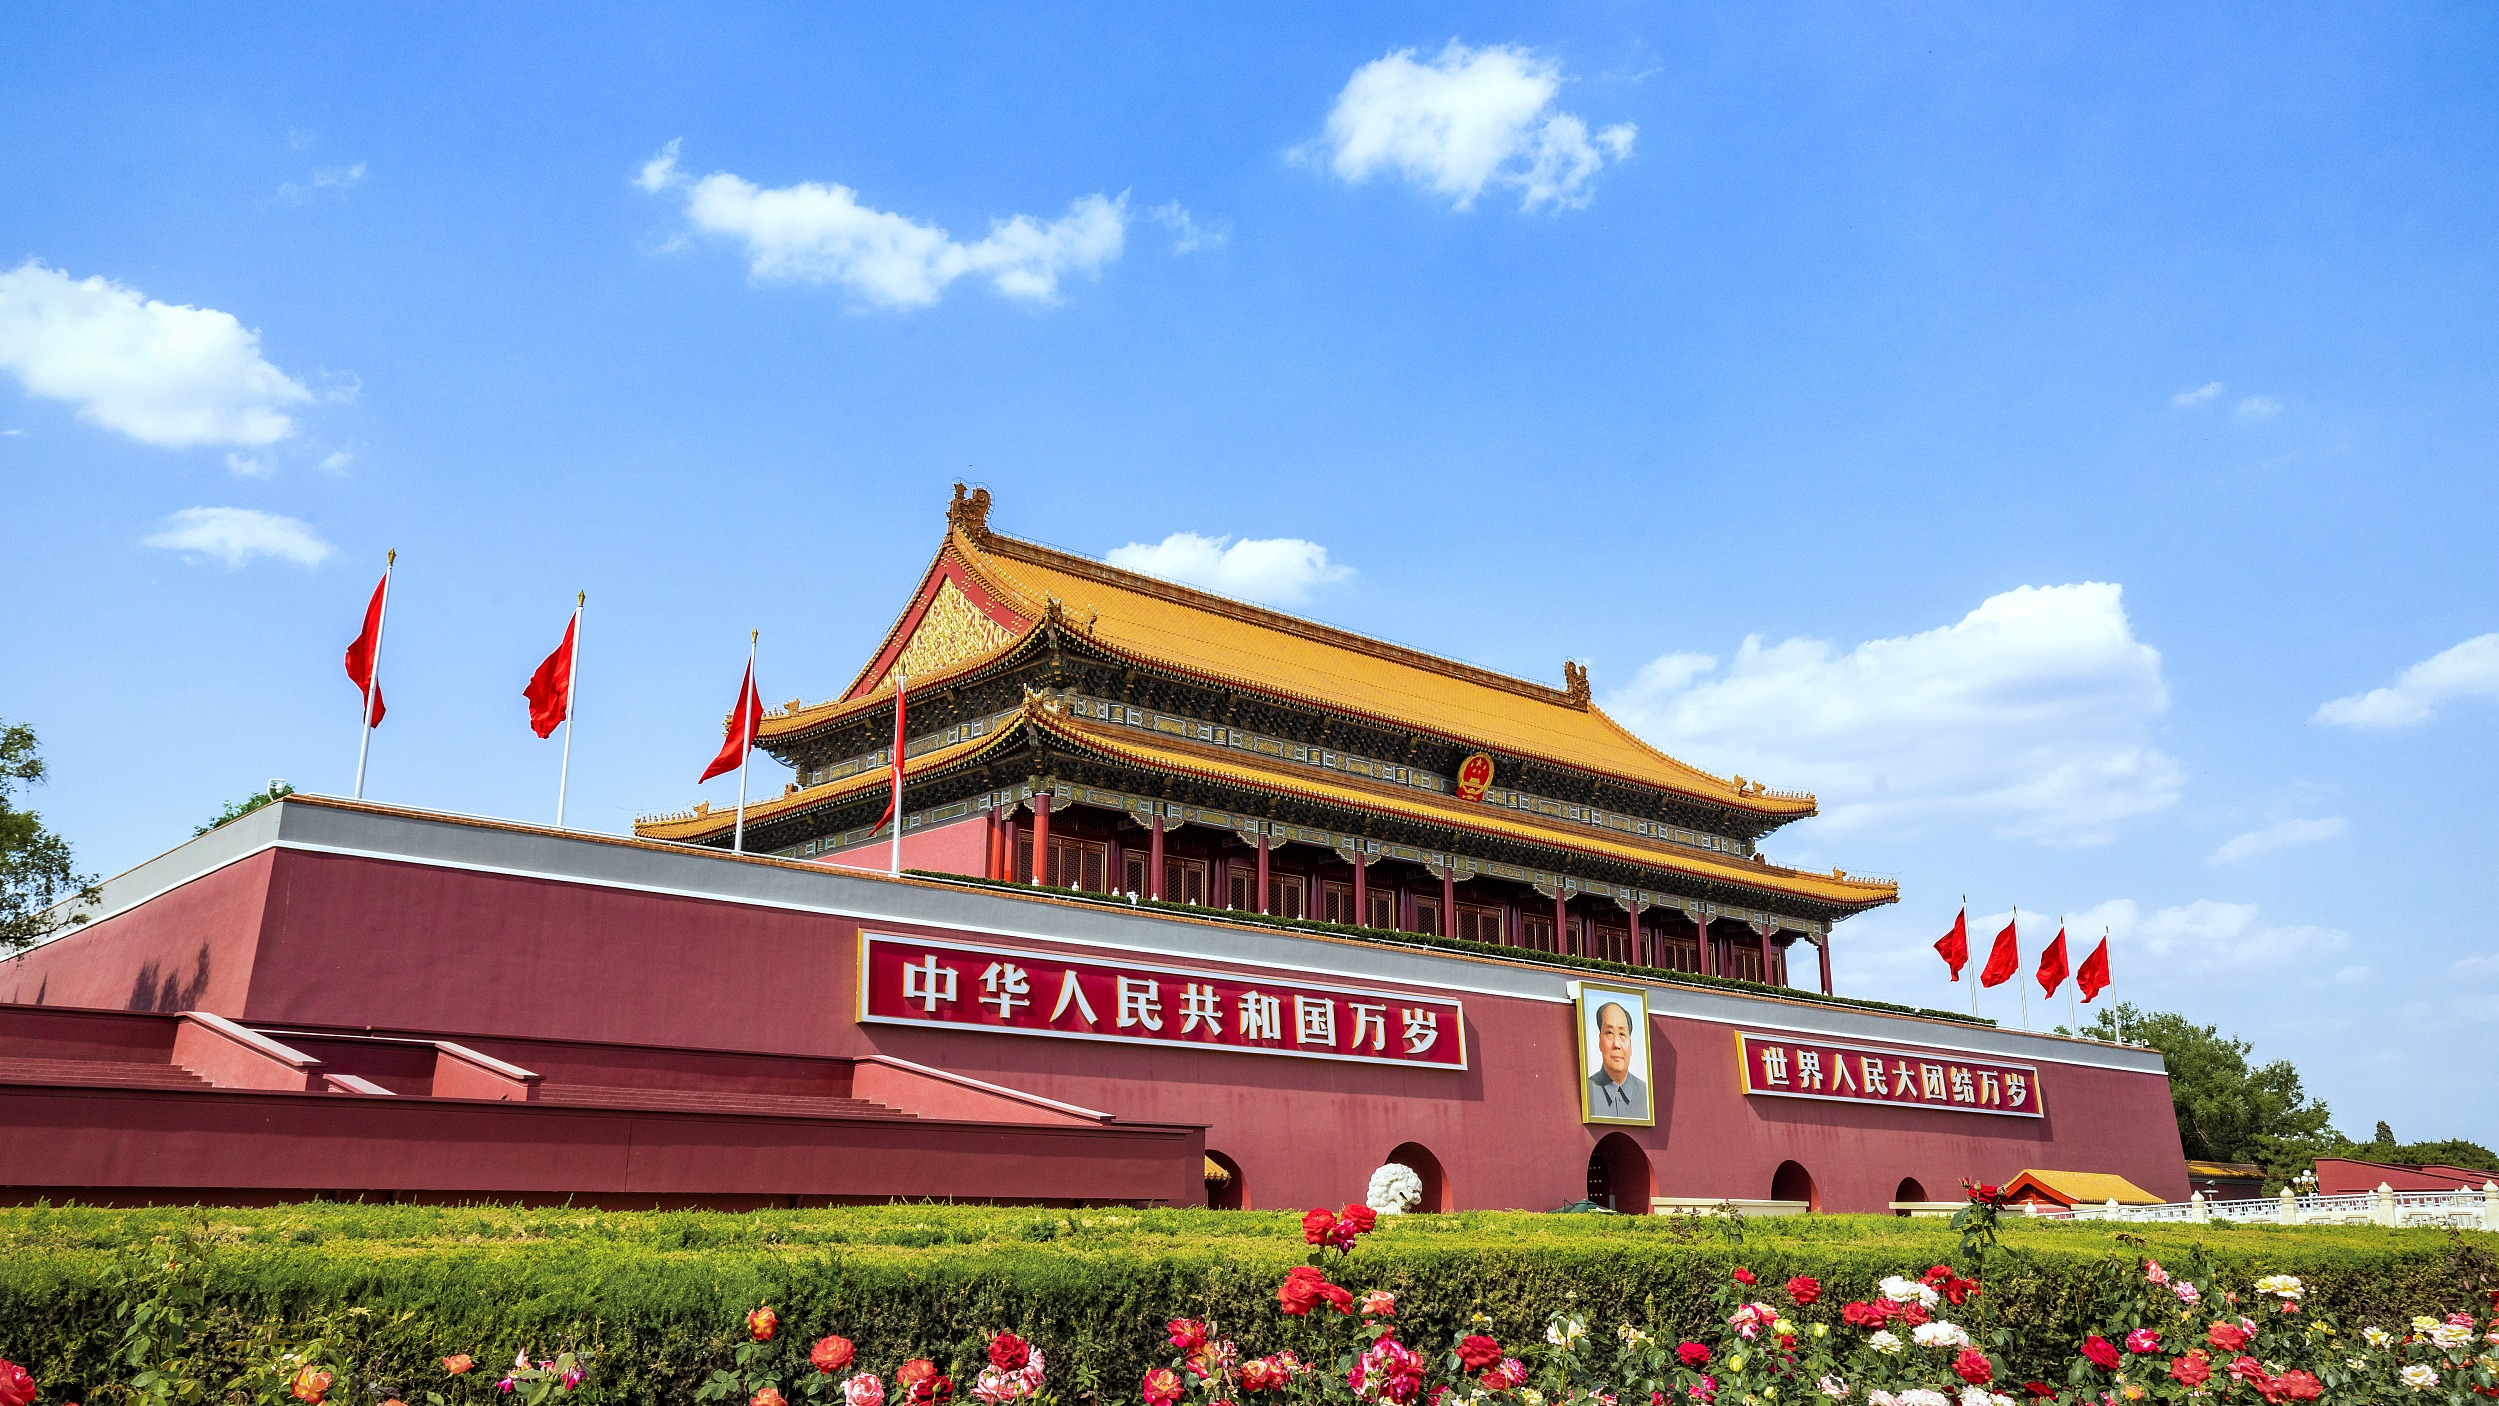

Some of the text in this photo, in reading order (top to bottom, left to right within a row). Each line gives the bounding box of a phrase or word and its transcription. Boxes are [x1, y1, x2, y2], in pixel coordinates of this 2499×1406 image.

[903, 954, 1439, 1054] 中华人民共和国万岁
[1762, 1046, 2027, 1107] 世界人民大团结万岁
